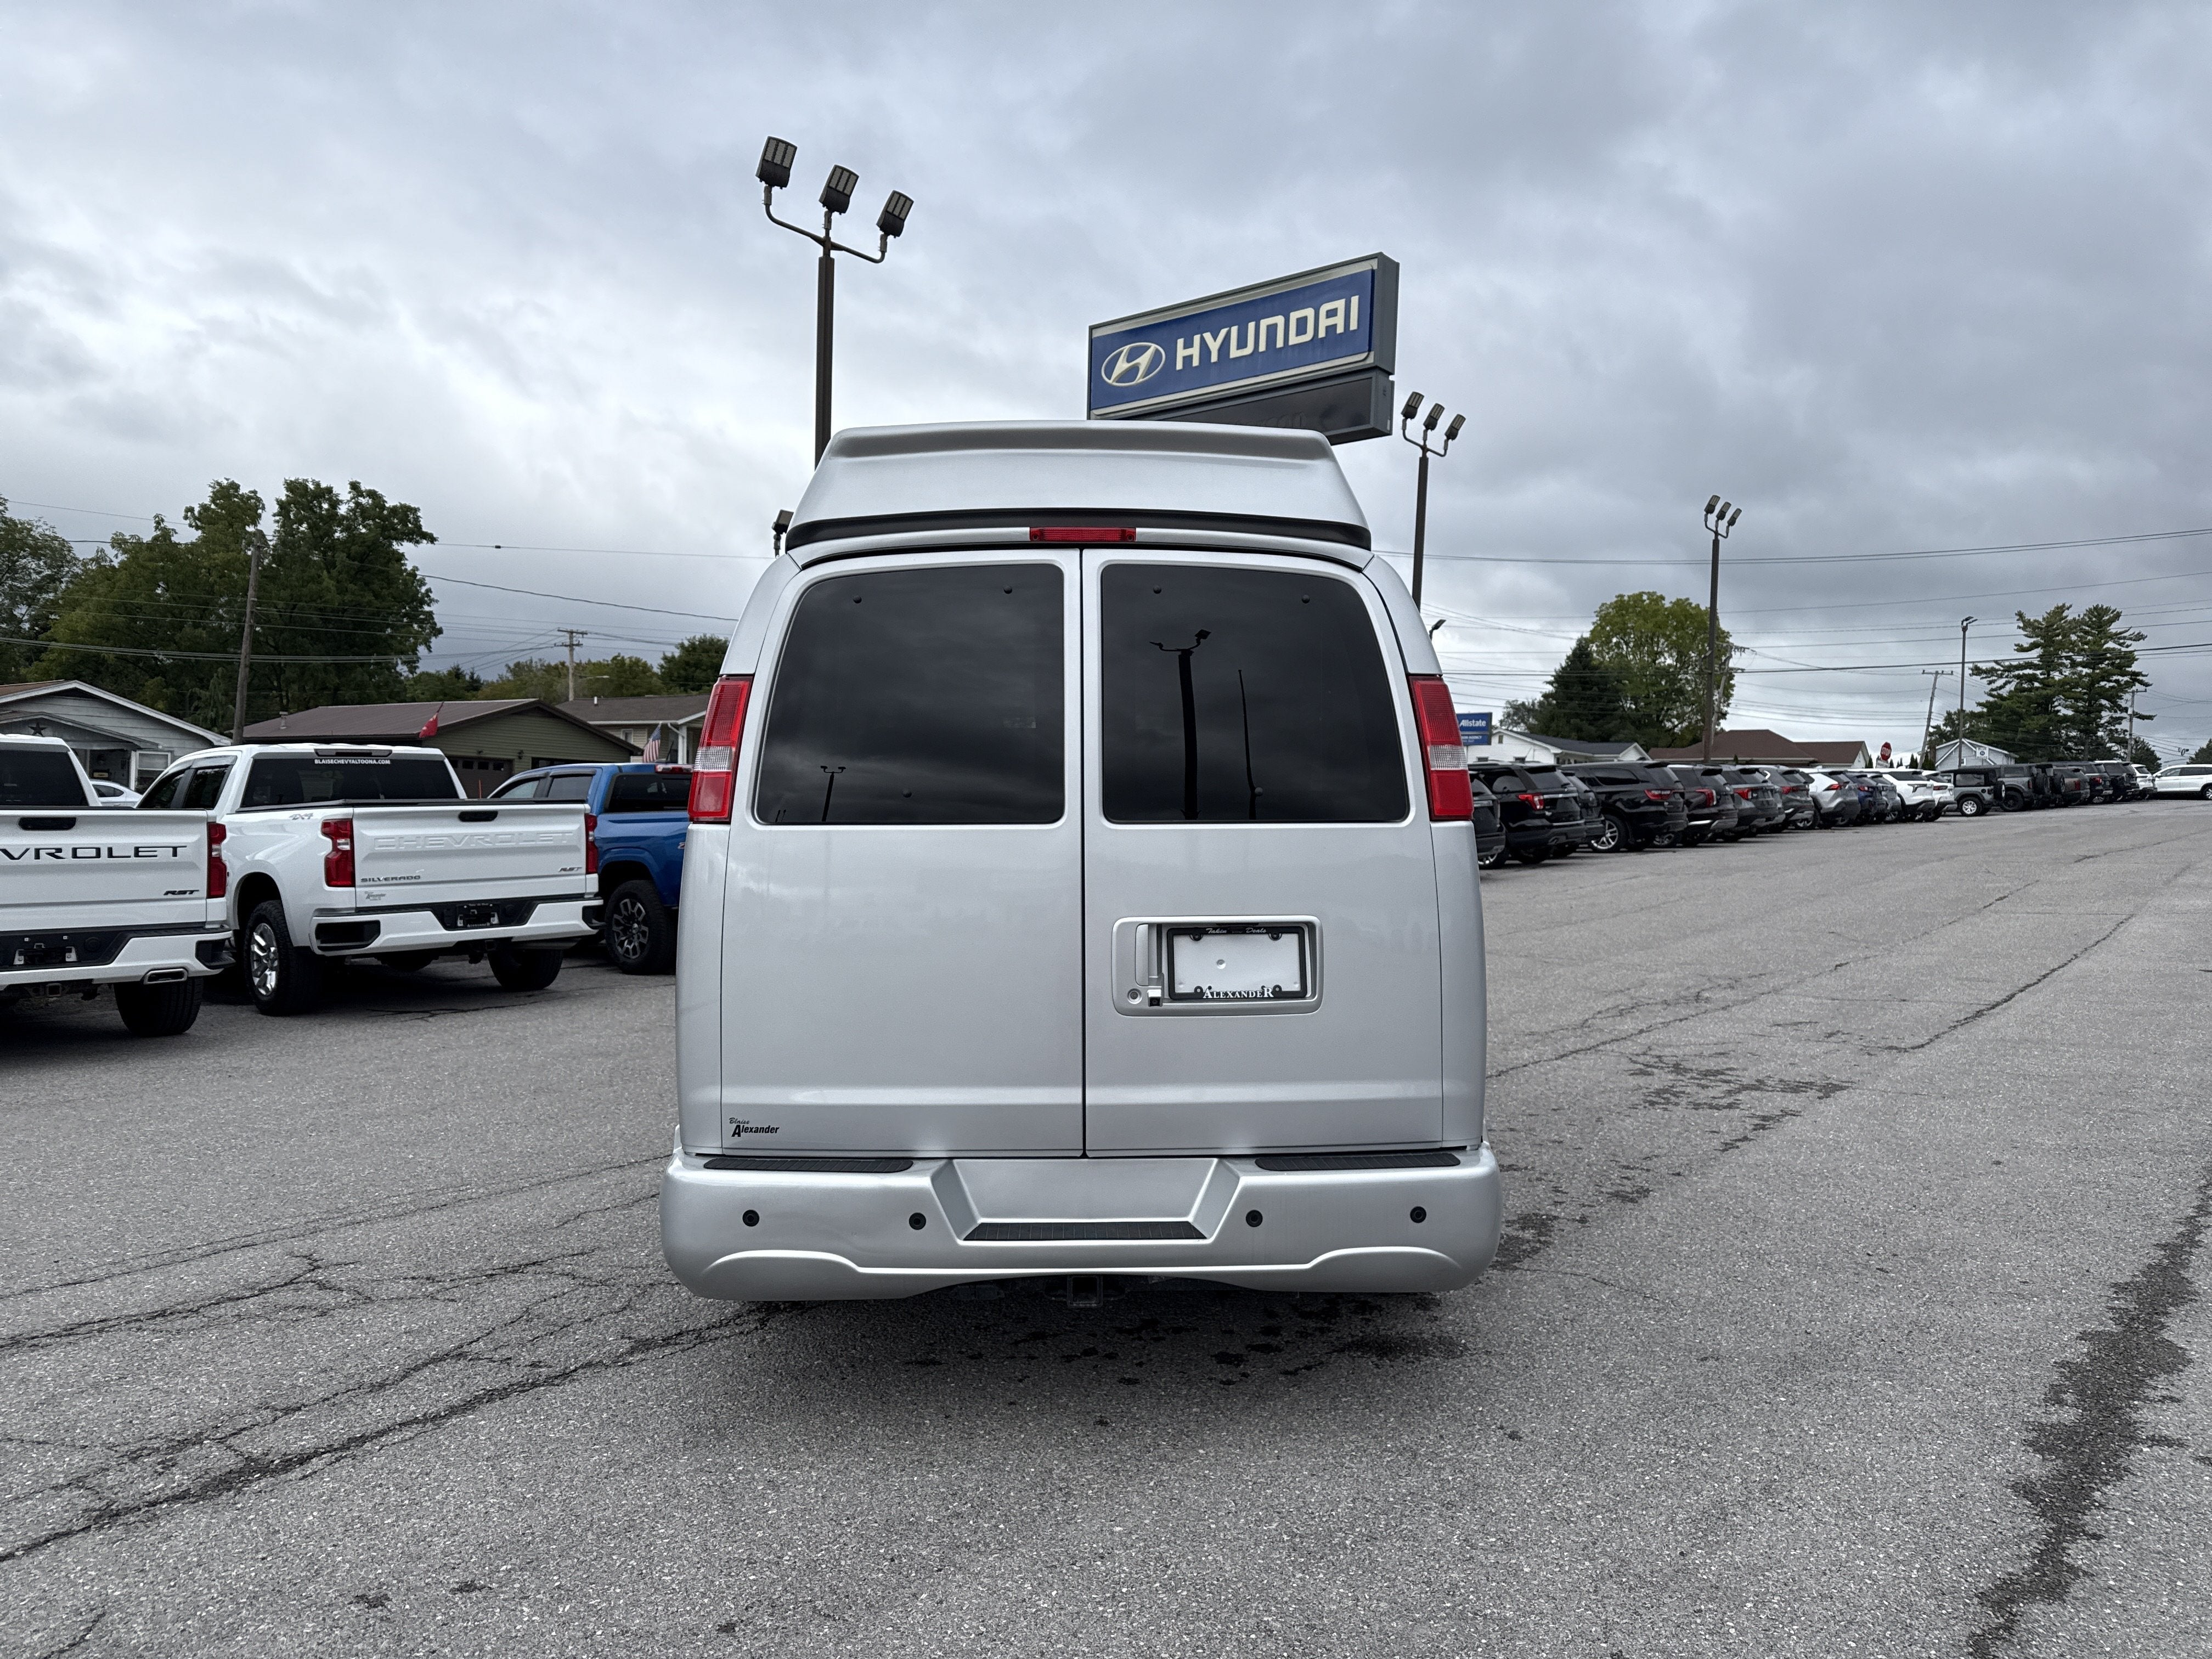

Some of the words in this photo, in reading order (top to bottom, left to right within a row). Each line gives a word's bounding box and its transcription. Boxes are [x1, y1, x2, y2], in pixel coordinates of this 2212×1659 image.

[1176, 295, 1359, 370] HYUNDAI
[374, 831, 573, 850] CHEVROLET
[1203, 988, 1274, 998] ALEXANDER
[731, 1125, 780, 1137] Alexander
